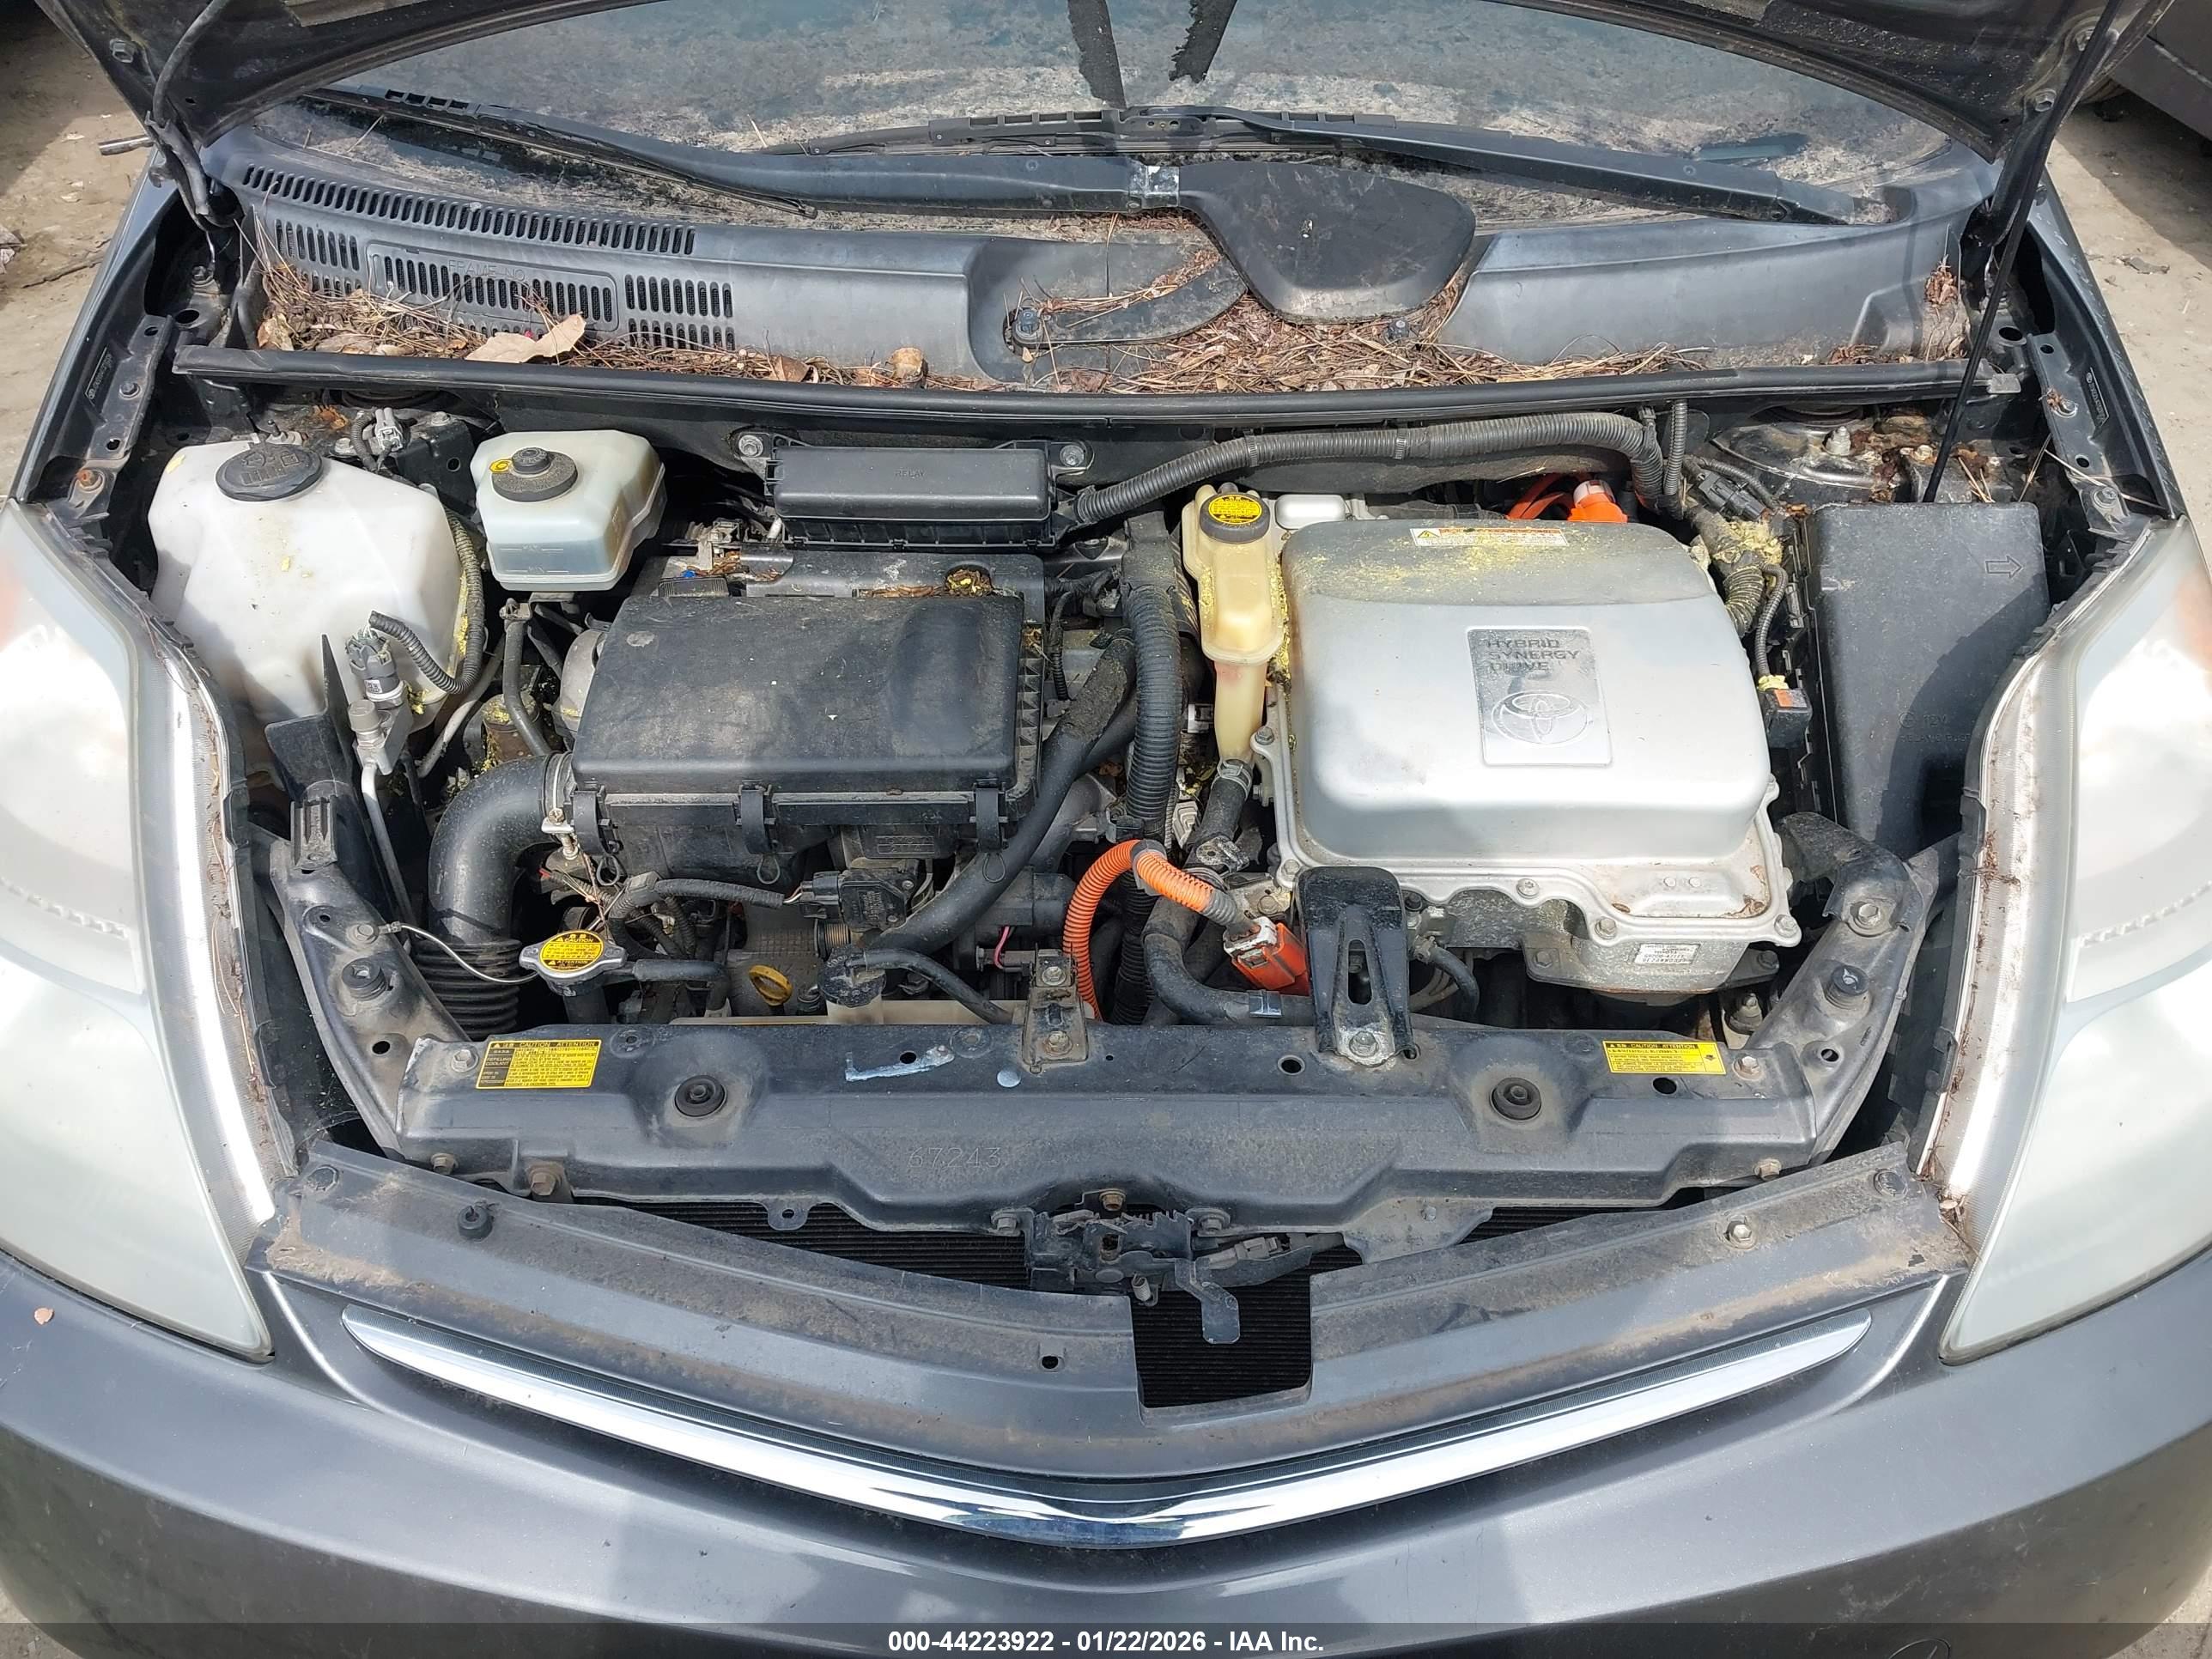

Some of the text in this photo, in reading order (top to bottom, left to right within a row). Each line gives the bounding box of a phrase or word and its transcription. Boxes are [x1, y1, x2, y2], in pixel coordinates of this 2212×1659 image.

[449, 260, 496, 278] FRAME
[894, 468, 927, 477] RELAY
[1487, 639, 1560, 648] HYBRID
[1489, 650, 1580, 659] SYNERGY
[908, 1146, 1001, 1168] 67243
